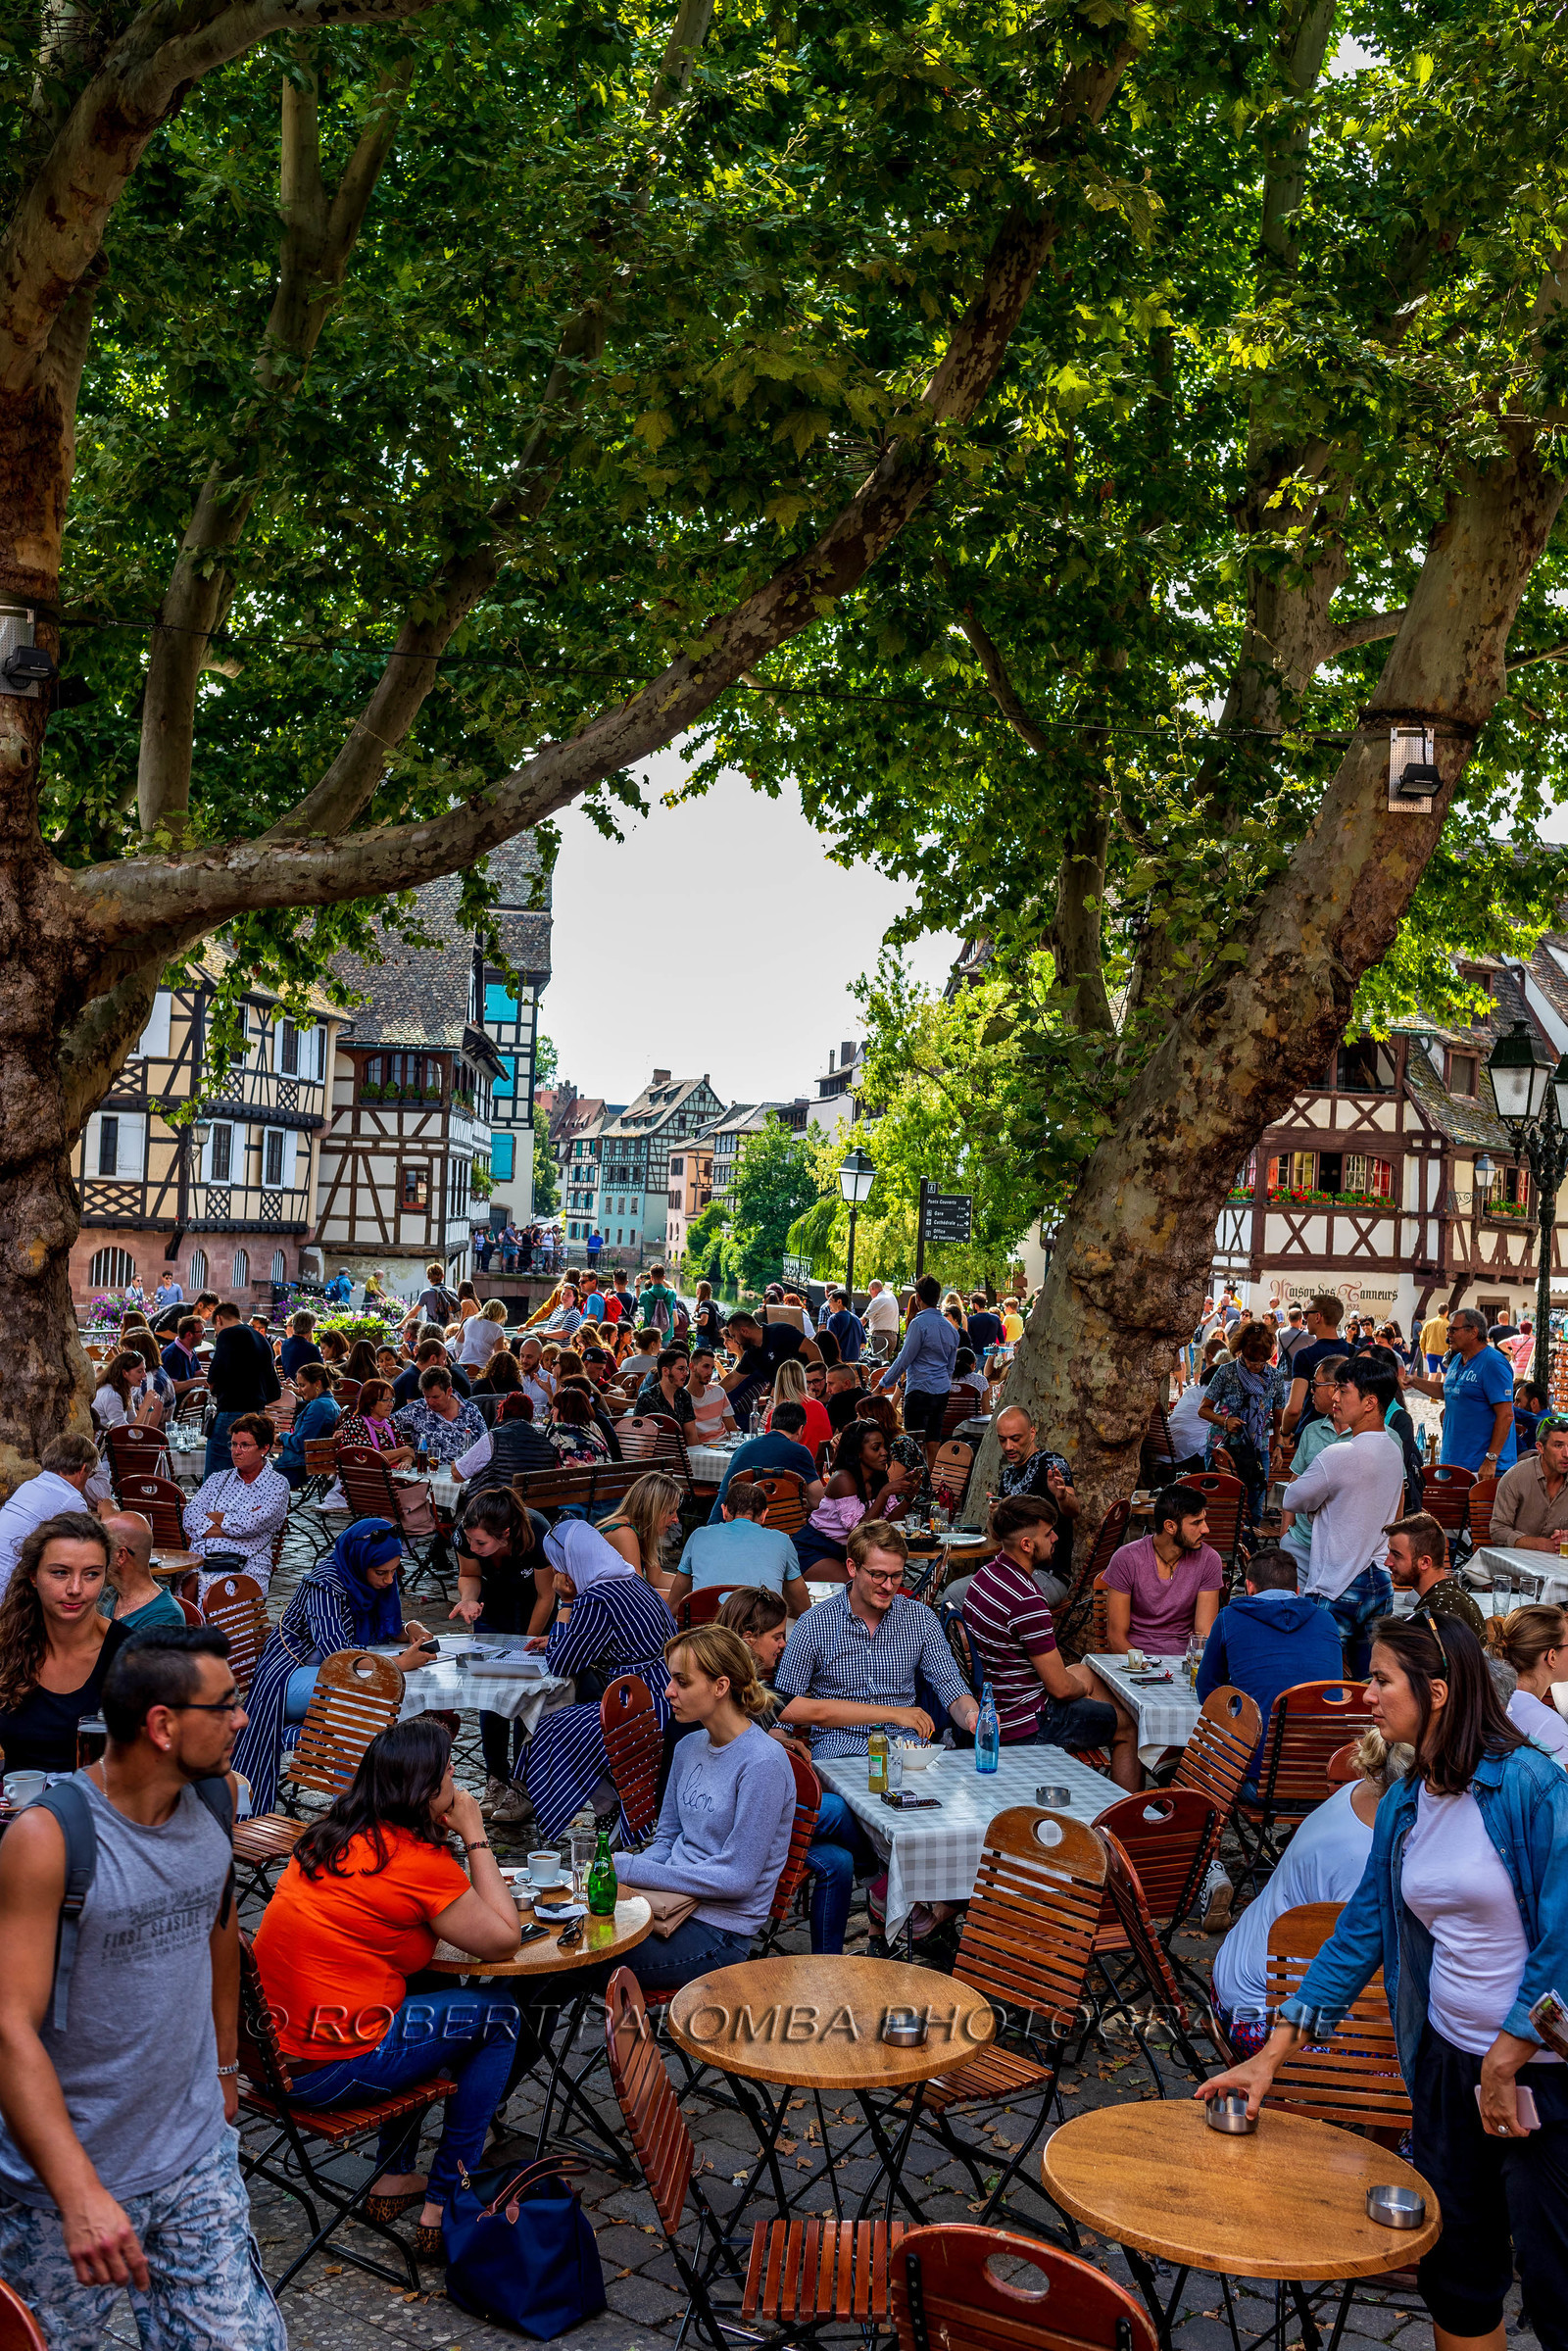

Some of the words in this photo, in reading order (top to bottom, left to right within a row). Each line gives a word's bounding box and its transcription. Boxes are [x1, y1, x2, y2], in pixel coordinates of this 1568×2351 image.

[1270, 1279, 1315, 1301] Maison
[1337, 1281, 1399, 1302] Tanneurs
[103, 1927, 142, 1949] FIRST
[151, 1912, 200, 1937] SEASIDE
